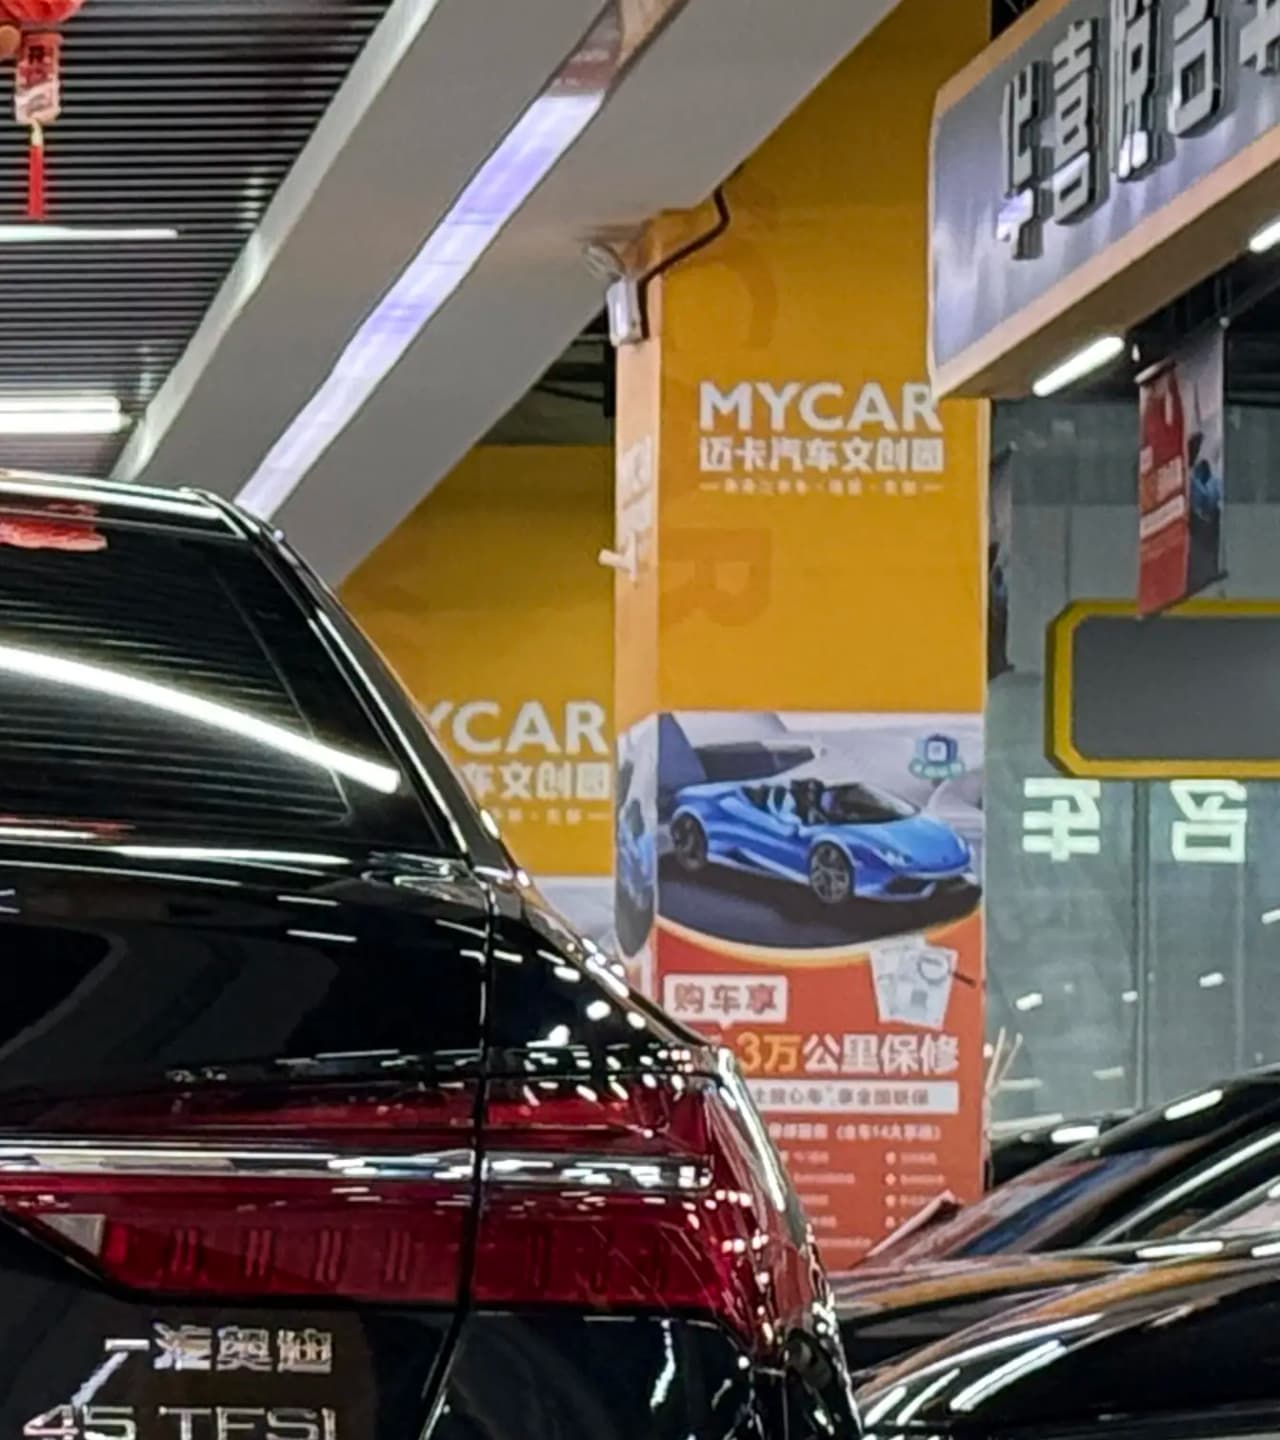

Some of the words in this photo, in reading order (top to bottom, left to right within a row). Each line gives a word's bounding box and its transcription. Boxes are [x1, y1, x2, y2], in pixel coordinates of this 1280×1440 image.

[699, 380, 944, 433] MYCAR
[673, 982, 778, 1015] 购车享
